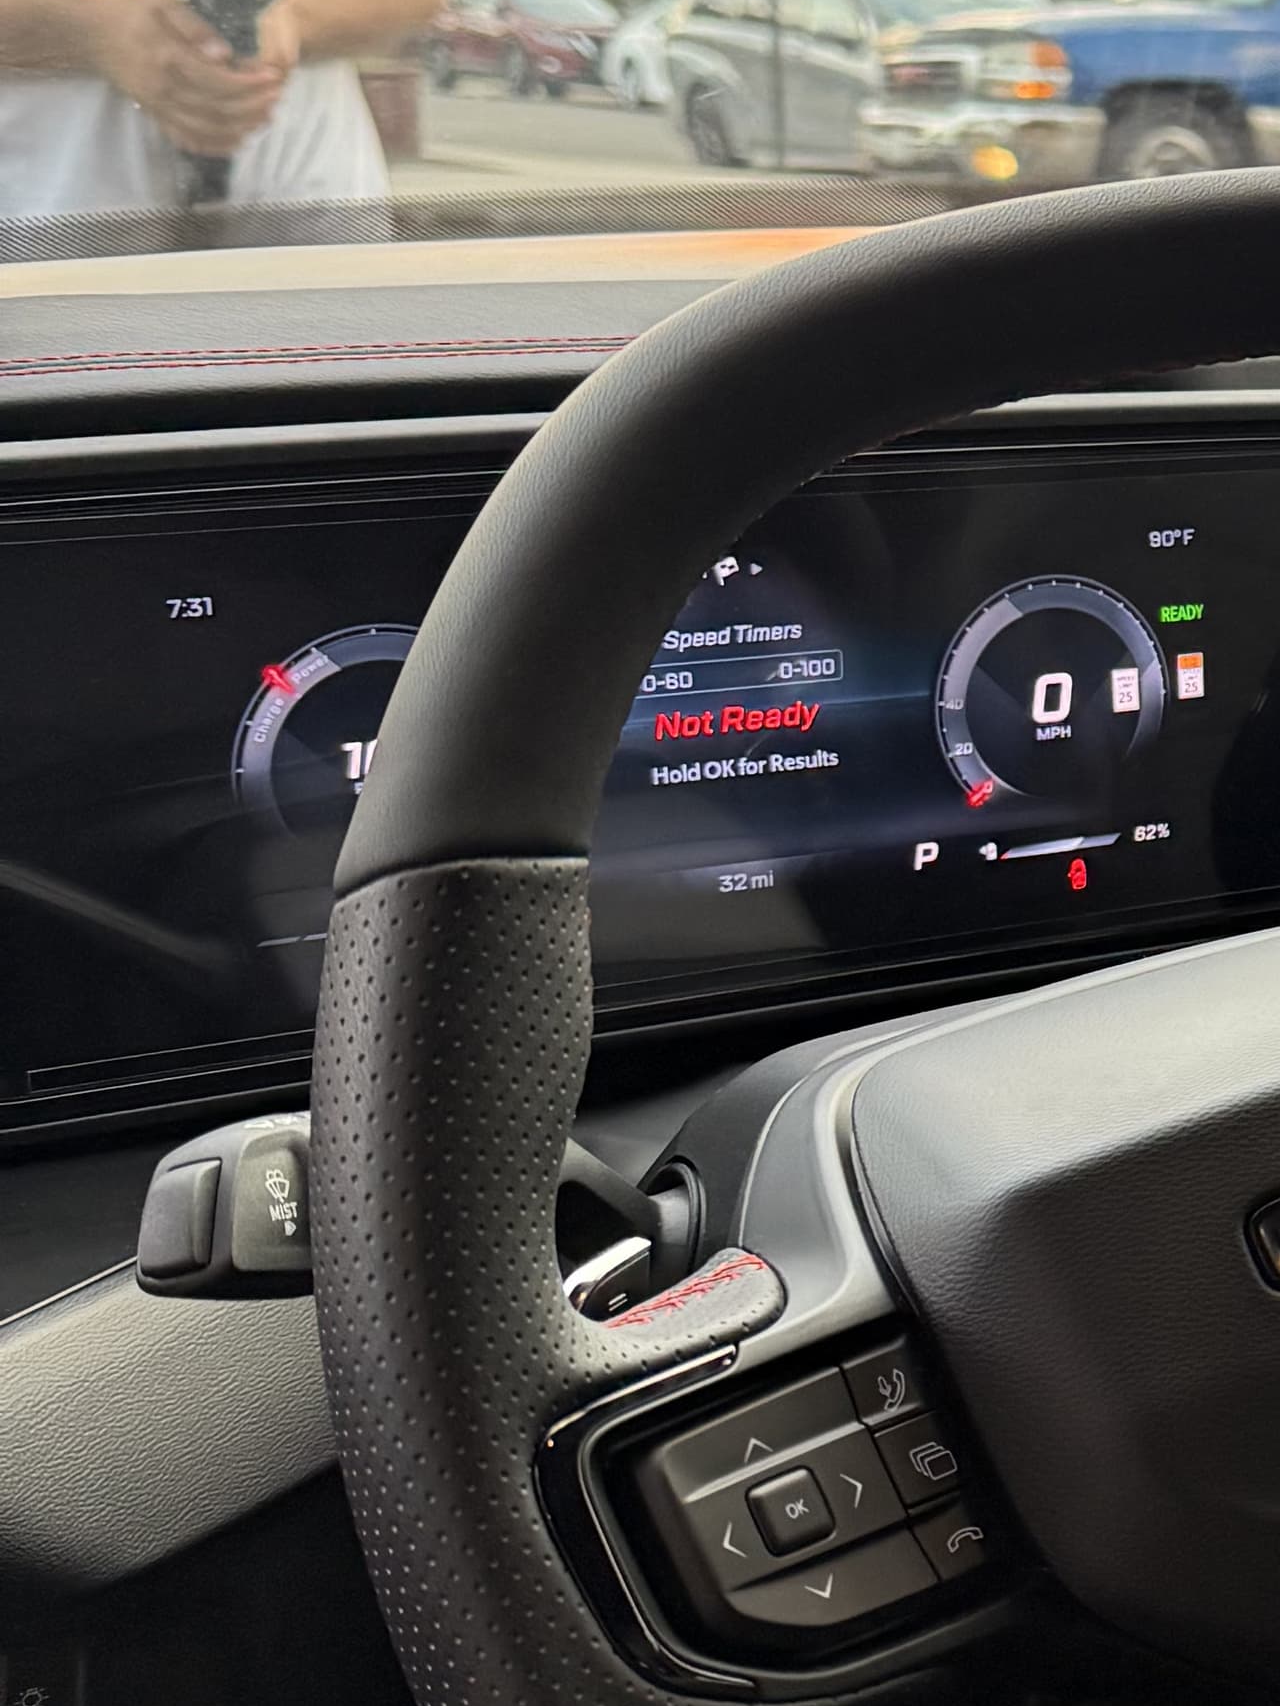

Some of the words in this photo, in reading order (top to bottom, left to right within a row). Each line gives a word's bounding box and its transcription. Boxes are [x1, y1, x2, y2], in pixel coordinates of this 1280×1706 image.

[166, 596, 214, 618] 7:31
[1159, 603, 1204, 623] READY
[662, 627, 731, 653] Speed
[733, 624, 803, 644] Timers
[779, 658, 836, 679] 0-100
[641, 671, 694, 692] 0-60
[1032, 672, 1073, 724] 0
[252, 697, 285, 743] Charge
[655, 711, 714, 741] Not
[720, 700, 820, 733] Ready
[1036, 725, 1072, 741] MPH
[954, 742, 973, 756] 20
[651, 763, 702, 786] Hold
[703, 759, 735, 780] OK
[737, 757, 766, 776] for
[769, 749, 839, 772] Results
[913, 841, 939, 871] P
[718, 873, 749, 894] 32
[750, 869, 775, 891] mi
[269, 1201, 298, 1222] MIST
[784, 1498, 810, 1519] OK
